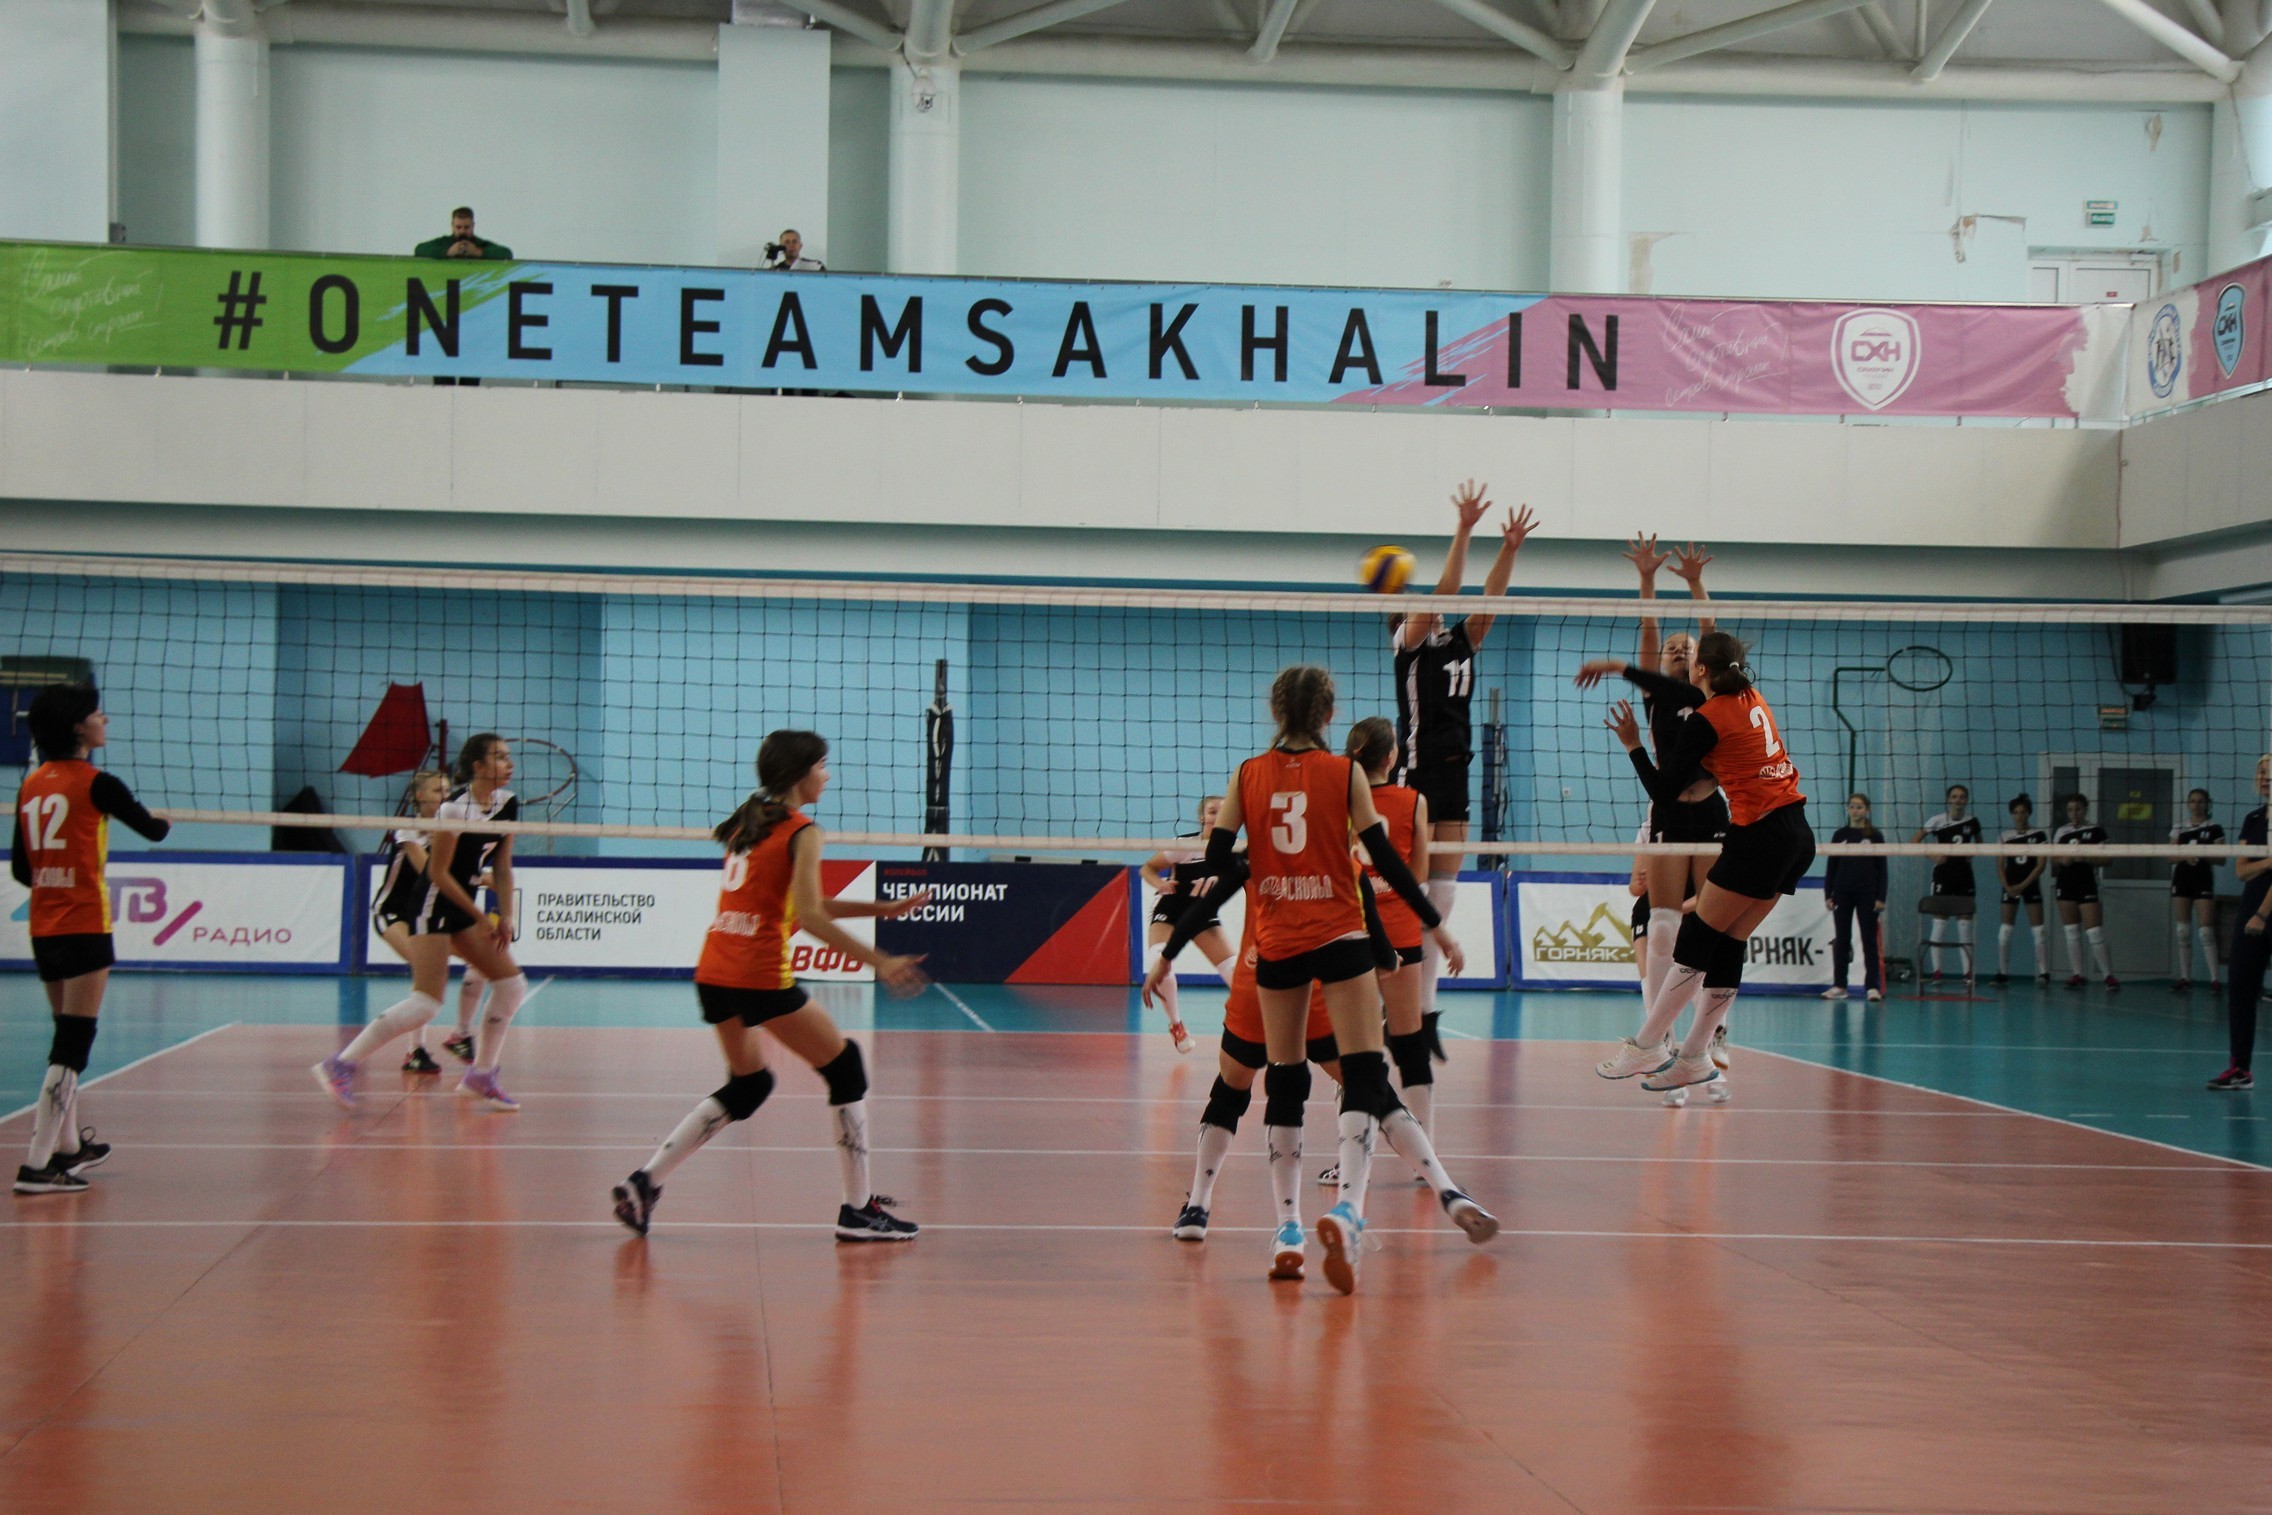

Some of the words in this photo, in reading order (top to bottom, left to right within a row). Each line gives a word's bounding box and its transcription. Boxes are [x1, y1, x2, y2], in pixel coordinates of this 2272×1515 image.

[213, 270, 1618, 391] #ONETEAMSAKHALIN
[1442, 657, 1471, 698] 11
[1749, 705, 1781, 758] 2
[21, 793, 69, 850] 12
[1270, 791, 1308, 854] 3
[537, 893, 656, 907] ПРАВИТЕЛЬСТВО
[882, 881, 1008, 901] ЧЕМПИОНАТ
[537, 908, 642, 925] САХАЛИНСКОЙ
[884, 904, 965, 922] ССИИ
[193, 927, 292, 947] РАДИО
[536, 927, 602, 941] ОБЛАСТИ
[1536, 946, 1636, 961] ГОРНЯК-
